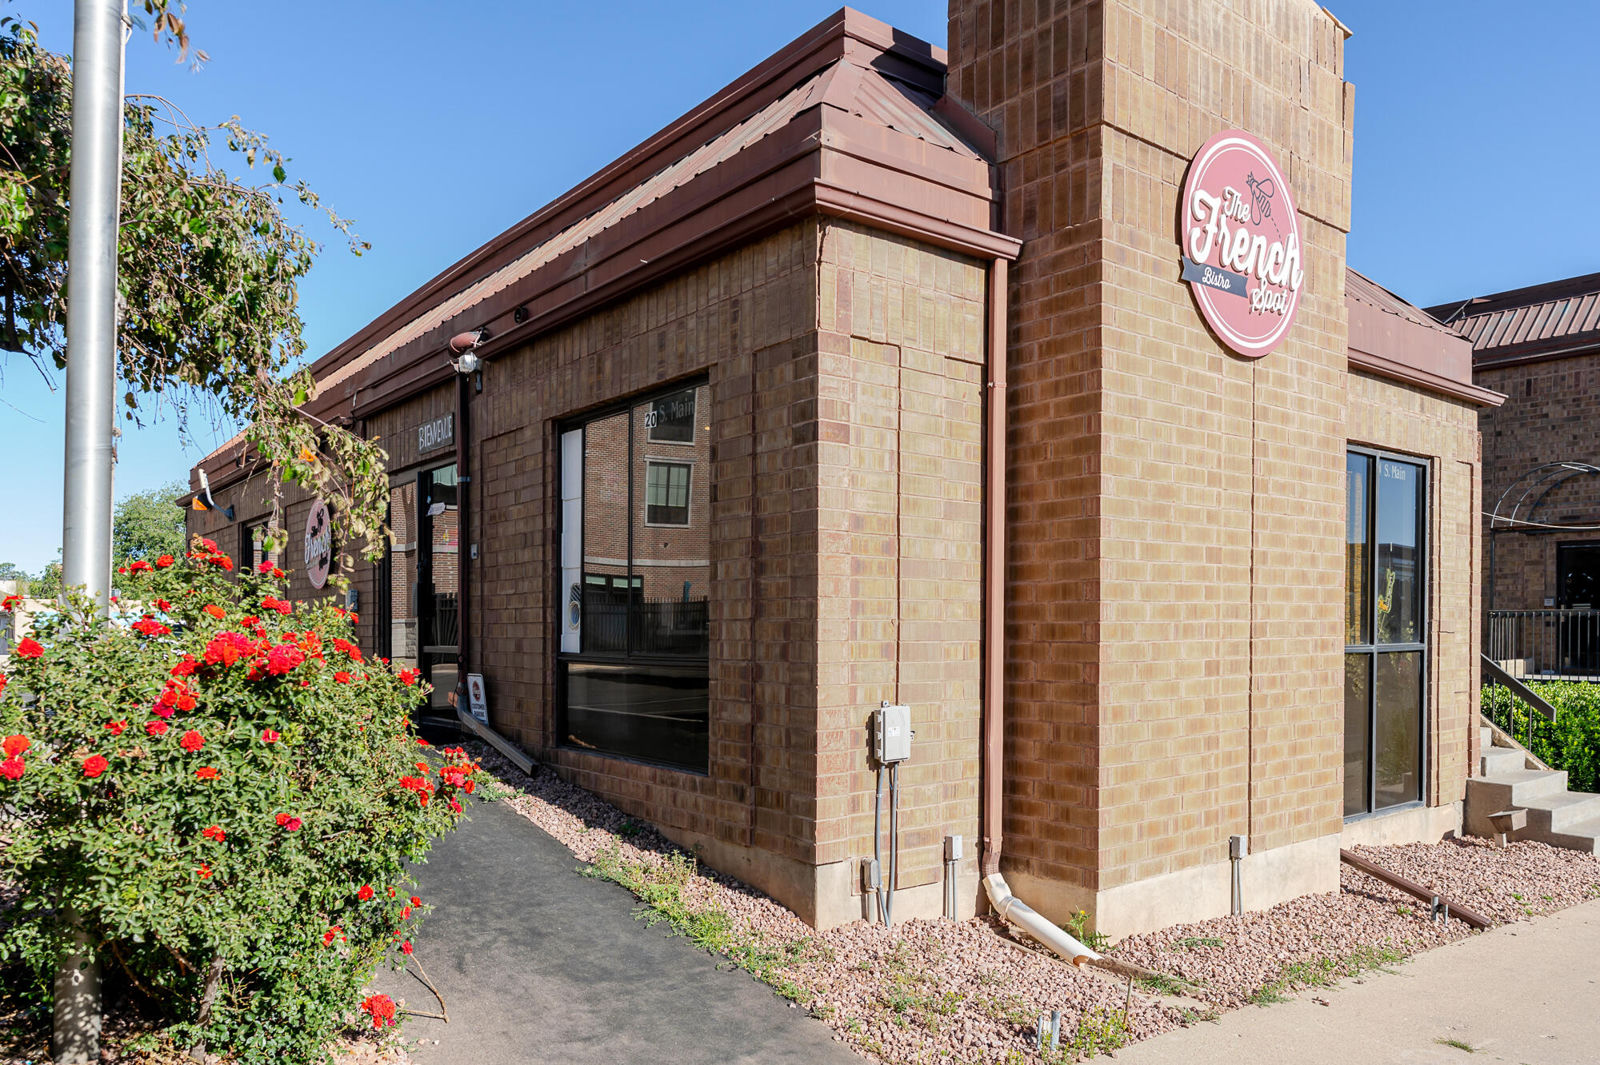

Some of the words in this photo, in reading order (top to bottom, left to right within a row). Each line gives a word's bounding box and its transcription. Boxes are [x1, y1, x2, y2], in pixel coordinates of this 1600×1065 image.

[1222, 186, 1250, 223] The
[1189, 189, 1303, 291] French
[1202, 267, 1231, 289] Bistro
[1250, 278, 1288, 315] Spot
[645, 412, 657, 428] 20
[671, 398, 694, 420] Main
[419, 415, 452, 450] BIENVENUE
[1391, 464, 1405, 480] Main
